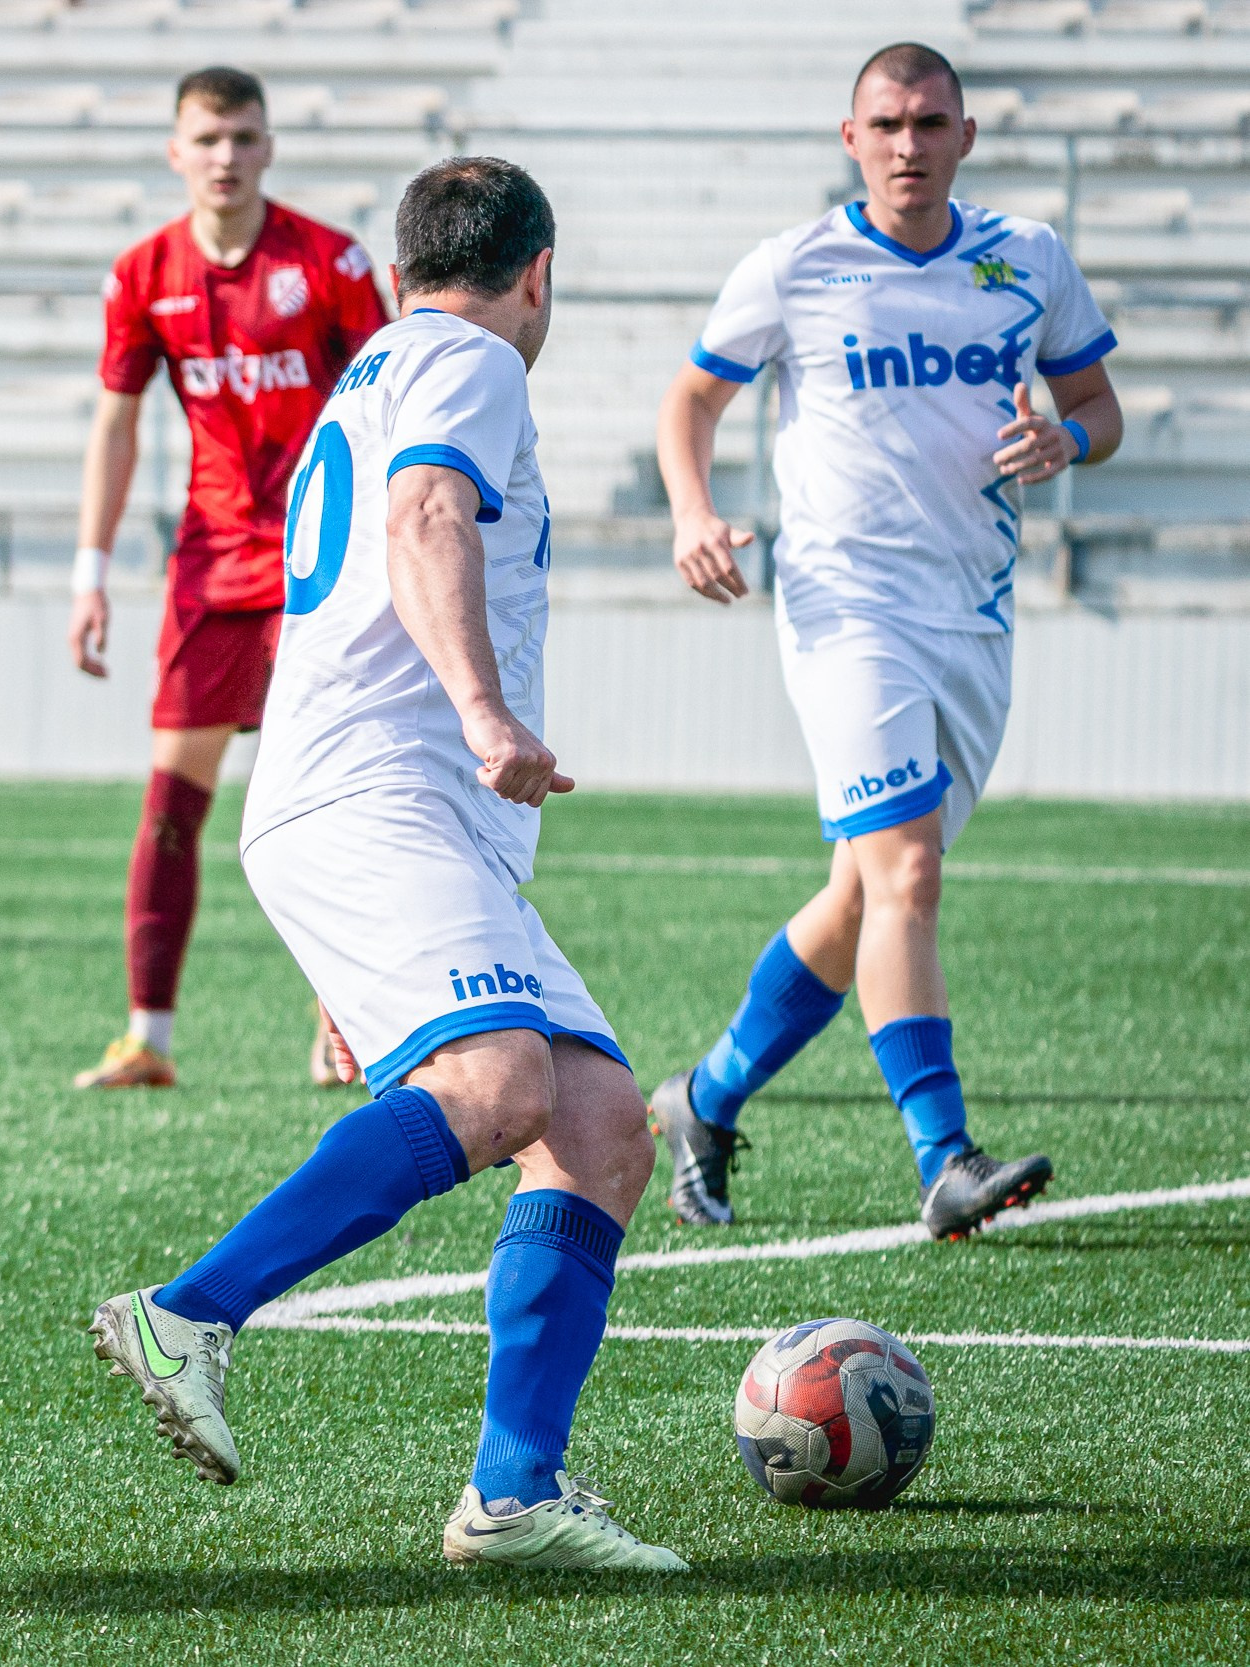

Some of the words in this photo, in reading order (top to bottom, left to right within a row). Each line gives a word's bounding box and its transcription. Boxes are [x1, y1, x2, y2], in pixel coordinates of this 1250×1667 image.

[843, 332, 1024, 390] inbet
[285, 420, 353, 615] 0
[840, 757, 922, 805] inbet
[449, 963, 545, 1001] inbe
